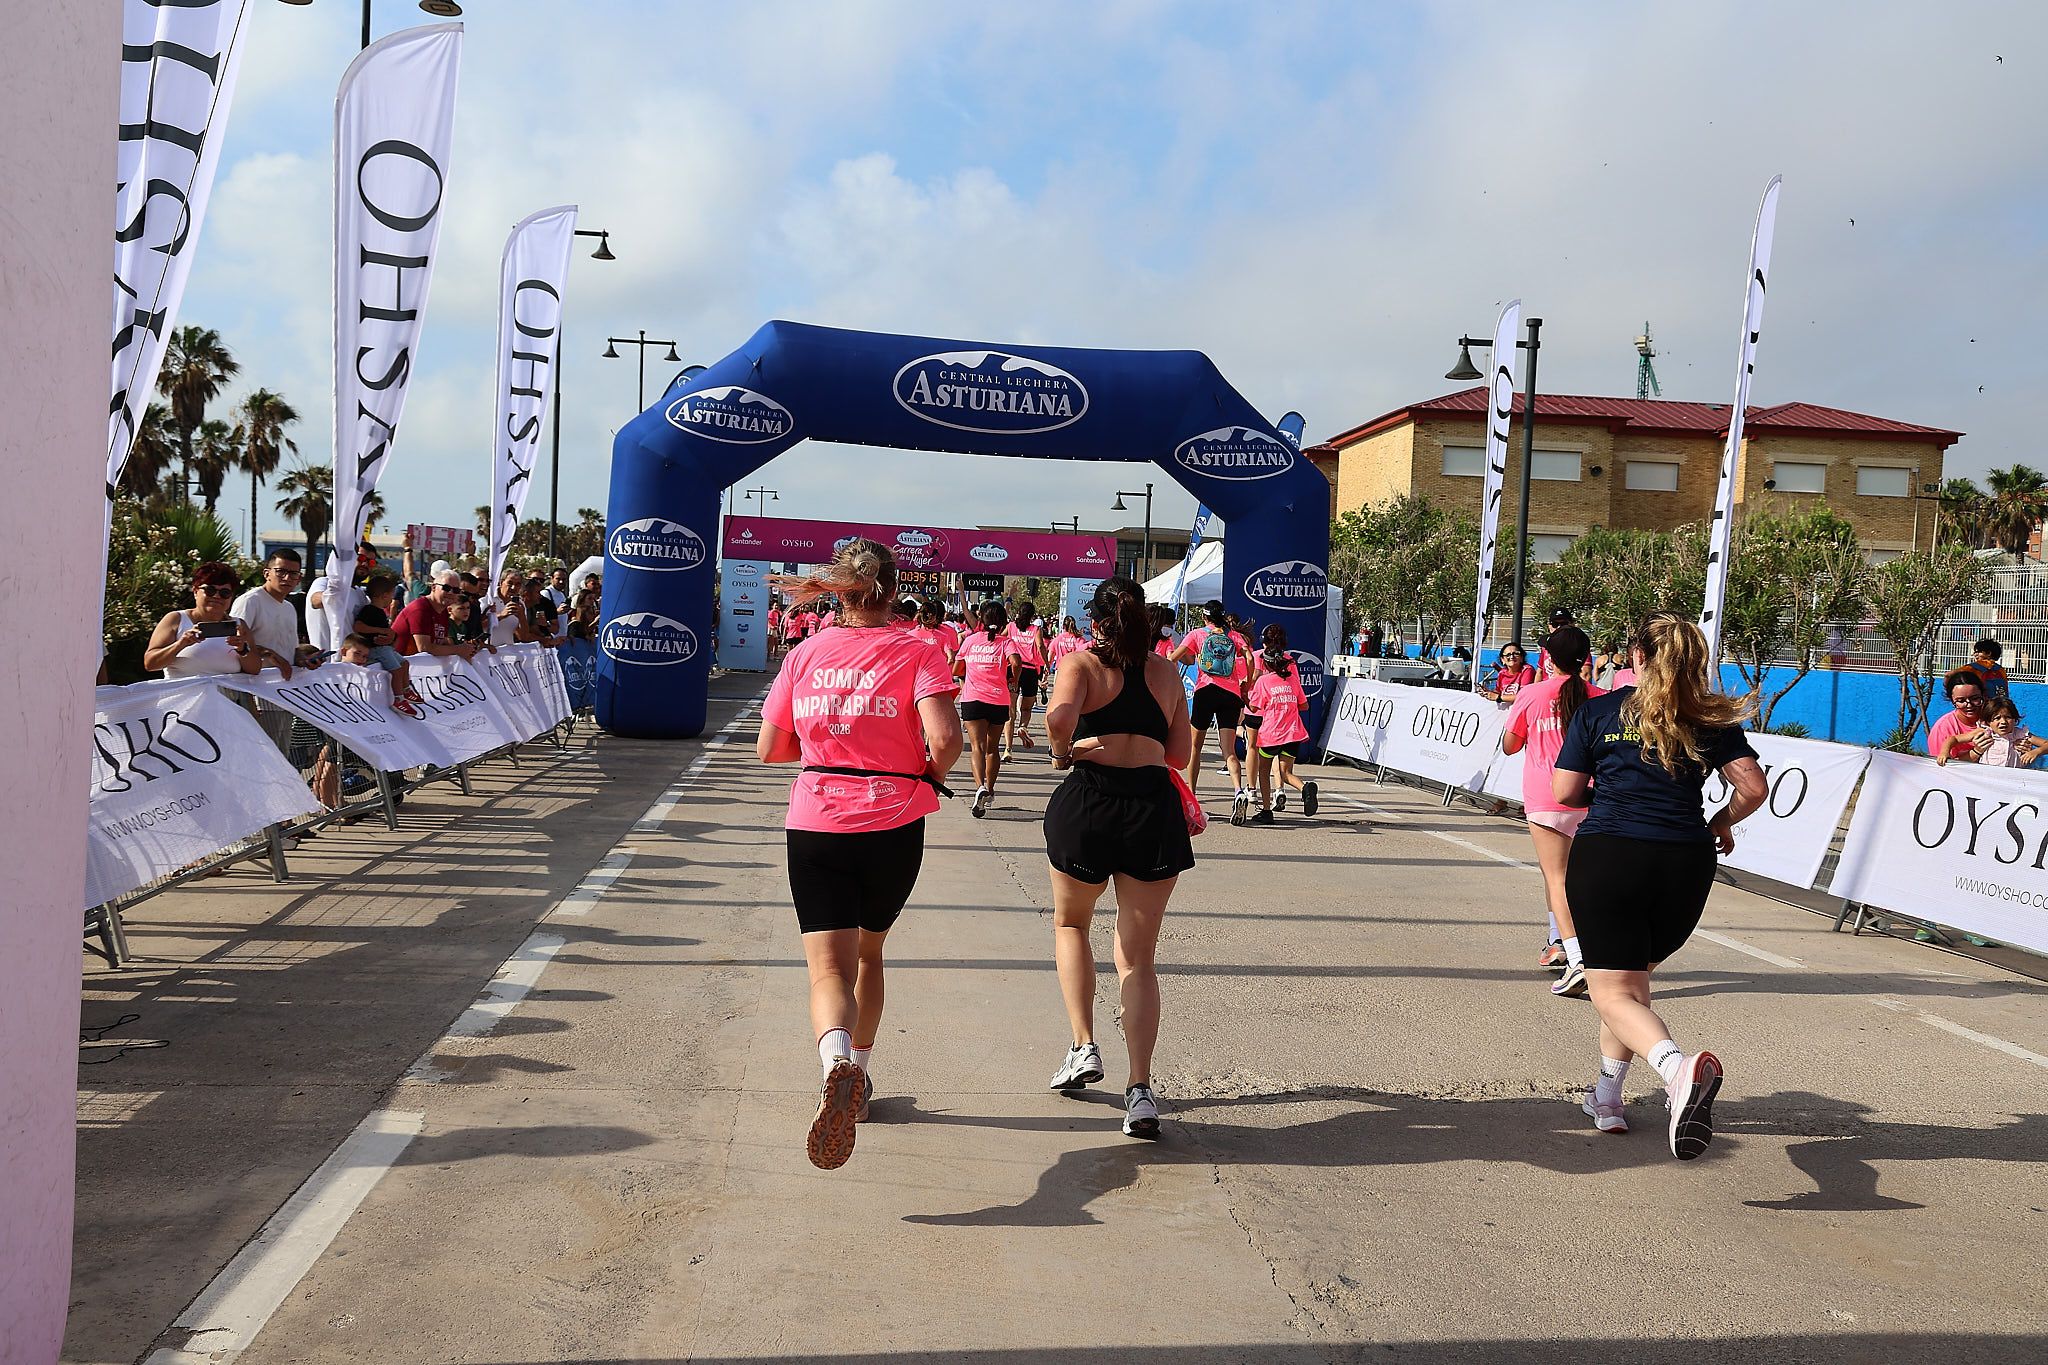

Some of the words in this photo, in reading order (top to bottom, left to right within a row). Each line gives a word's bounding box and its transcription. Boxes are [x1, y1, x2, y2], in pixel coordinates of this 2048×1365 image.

[939, 370, 1001, 385] CENTRAL
[1007, 377, 1069, 390] LECHERA
[907, 370, 1074, 417] ASTURIANA
[696, 401, 739, 412] CENTRAL
[673, 401, 783, 434] ASTURIANA
[1184, 446, 1288, 467] ASTURIANA
[613, 535, 699, 561] ASTURIANA
[731, 537, 762, 546] Santander
[781, 539, 814, 548] OYSHO
[1027, 552, 1059, 561] OYSHO
[1076, 556, 1106, 564] Santander
[968, 579, 999, 587] OYSHO
[604, 629, 690, 654] ASTURIANA
[812, 668, 876, 690] SOMOS
[793, 694, 898, 719] IMPARABLES
[1339, 692, 1394, 730] OYSHO
[829, 723, 850, 735] 2026
[1412, 704, 1480, 748] OYSHO
[1604, 733, 1620, 743] EN
[102, 791, 211, 840] WWW.OYSHO.COM
